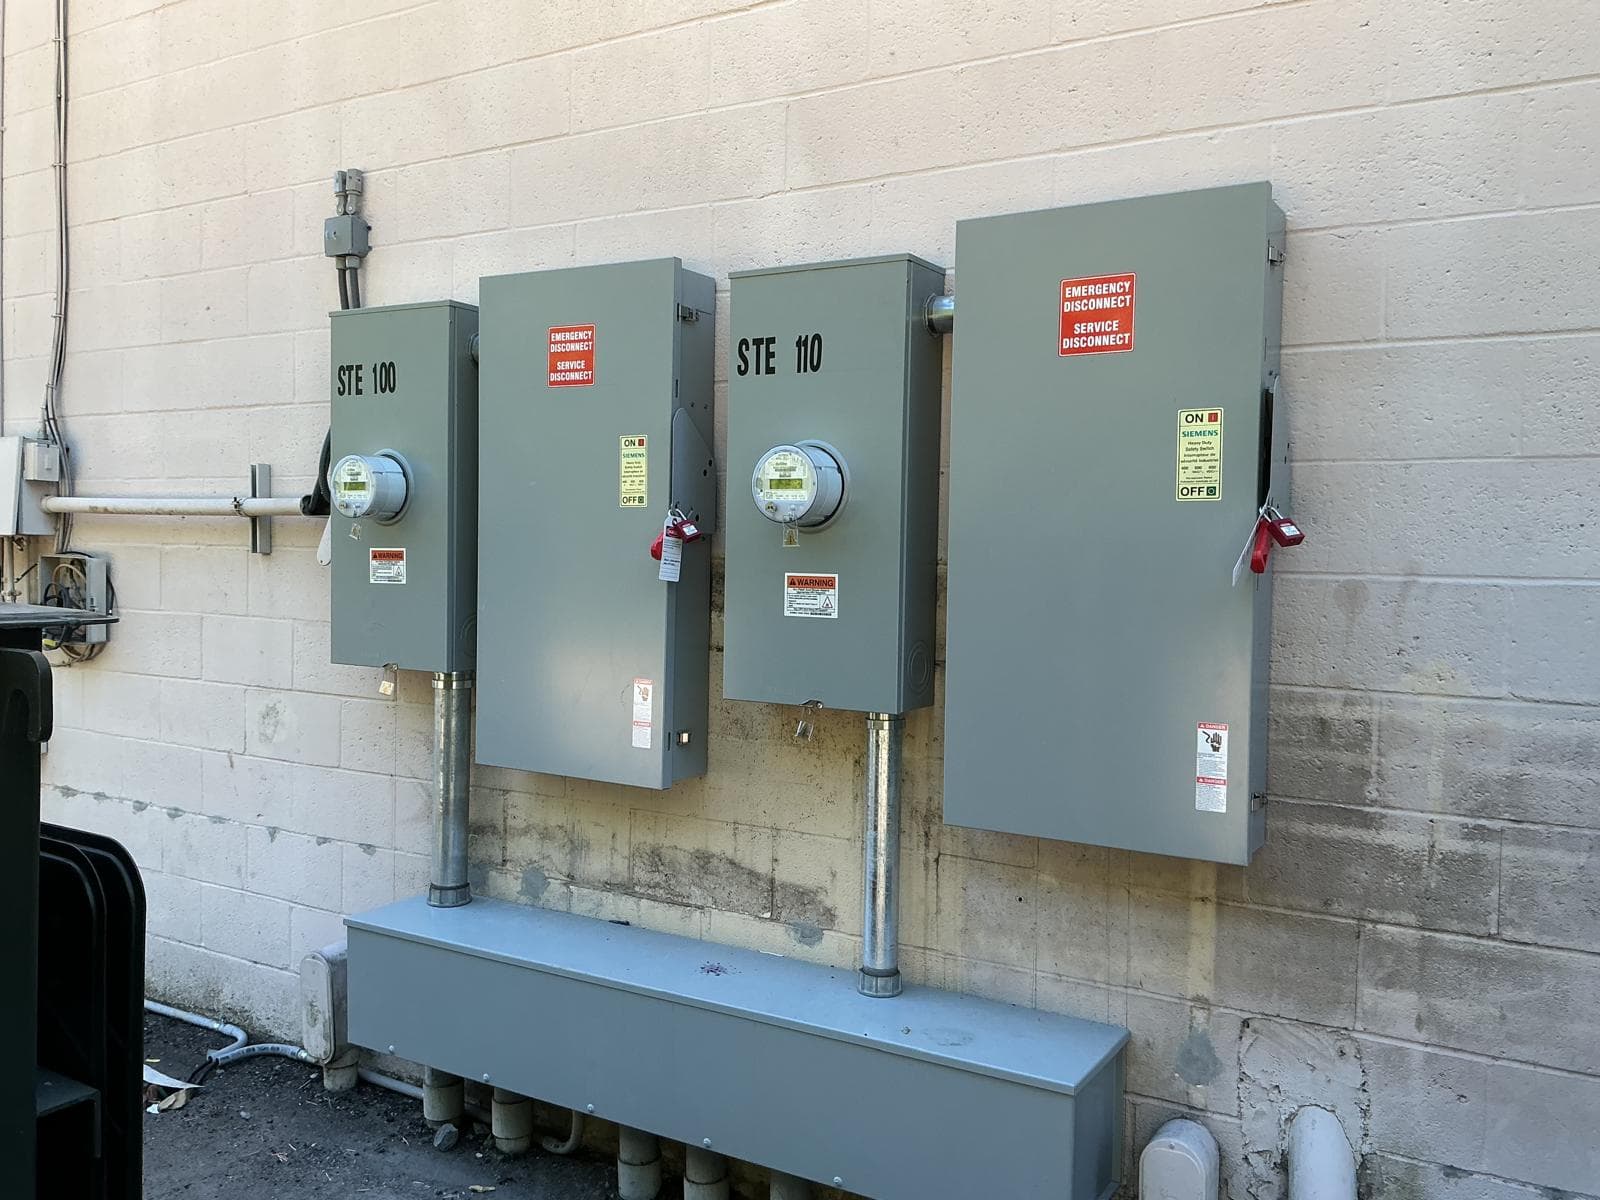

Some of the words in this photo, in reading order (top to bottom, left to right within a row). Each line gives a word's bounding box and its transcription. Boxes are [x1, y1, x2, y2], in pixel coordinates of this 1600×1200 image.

[1065, 281, 1131, 298] EMERGENCY
[1063, 295, 1132, 312] DISCONNECT
[1073, 320, 1119, 334] SERVICE
[551, 331, 592, 341] EMERGENCY
[1062, 333, 1131, 349] DISCONNECT
[550, 342, 592, 352] DISCONNECT
[737, 336, 776, 376] STE
[796, 333, 822, 373] 110
[557, 360, 586, 370] SERVICE
[338, 364, 363, 396] STE
[373, 361, 396, 394] 100
[550, 371, 592, 381] DISCONNECT
[1185, 413, 1204, 423] ON
[1182, 430, 1218, 438] SIEMENS
[624, 439, 636, 447] ON
[1180, 486, 1205, 496] OFF
[622, 496, 637, 504] OFF
[798, 578, 834, 587] WARNING
